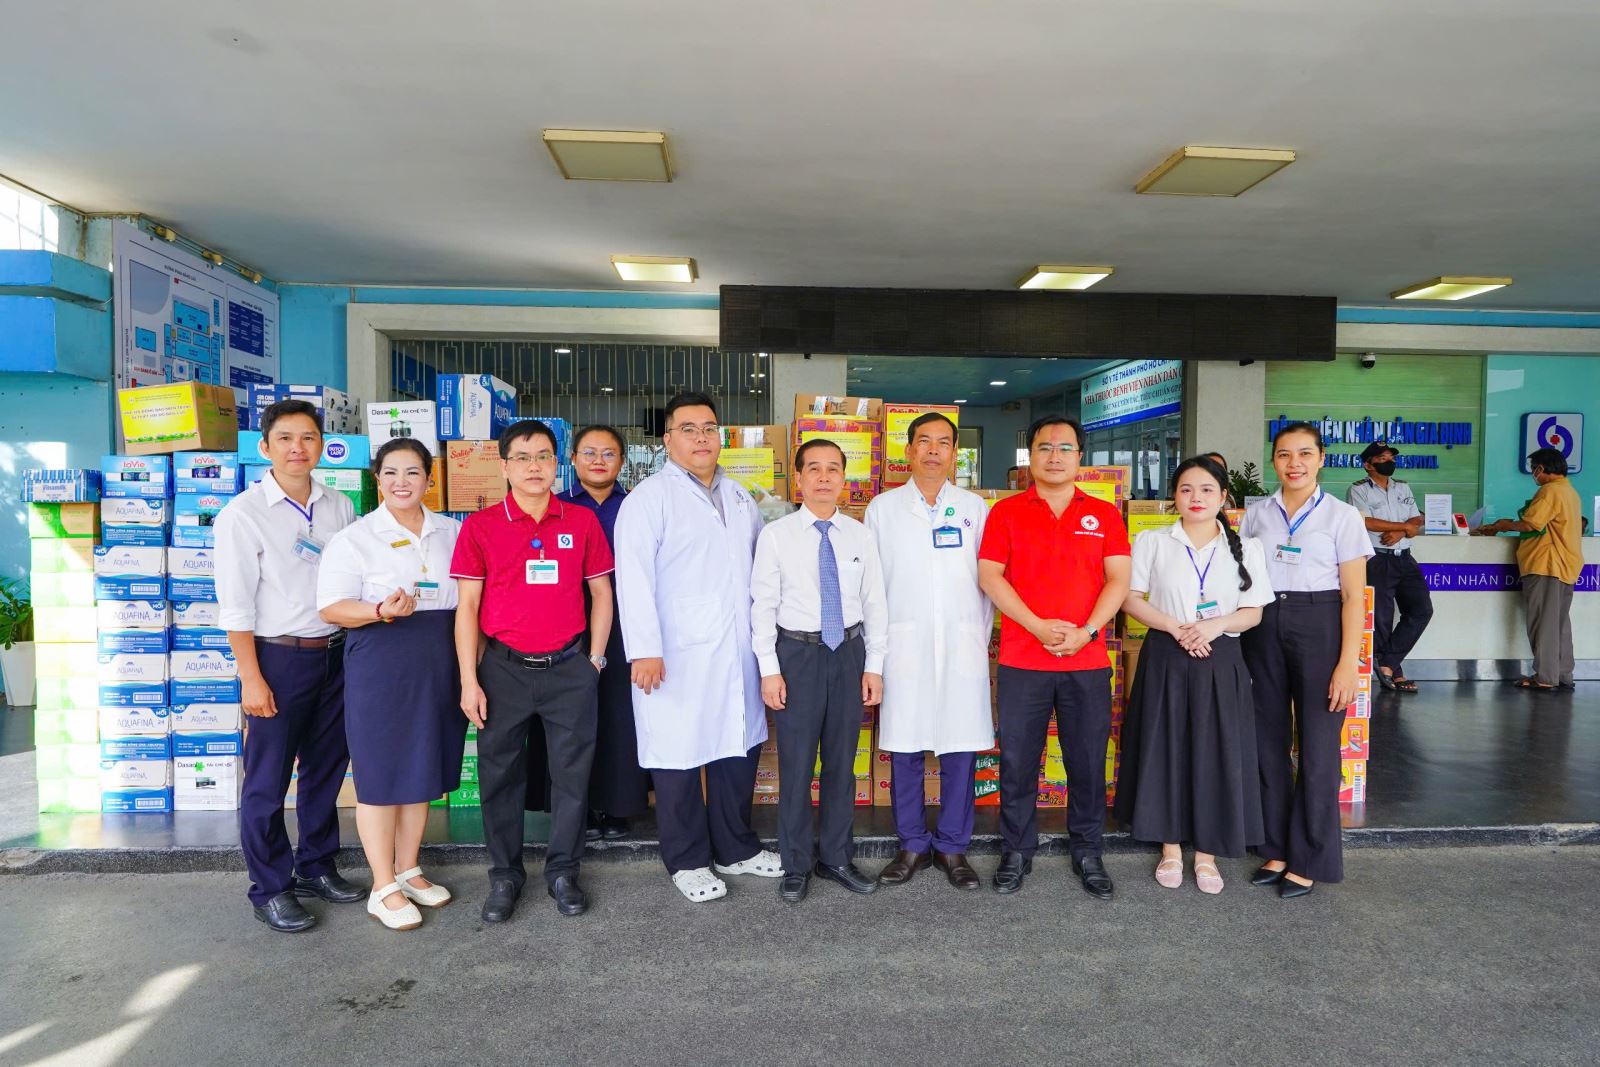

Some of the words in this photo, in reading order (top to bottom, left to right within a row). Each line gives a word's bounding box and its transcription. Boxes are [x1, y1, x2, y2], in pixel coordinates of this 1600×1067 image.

[1415, 422, 1438, 445] GIA
[115, 507, 146, 516] AQUAFINA
[183, 560, 214, 569] AQUAFIN
[1458, 572, 1498, 586] NHÂN
[1575, 575, 1600, 588] ĐỊN
[185, 661, 223, 671] AQUAFINA
[117, 718, 154, 728] AQUAFINA
